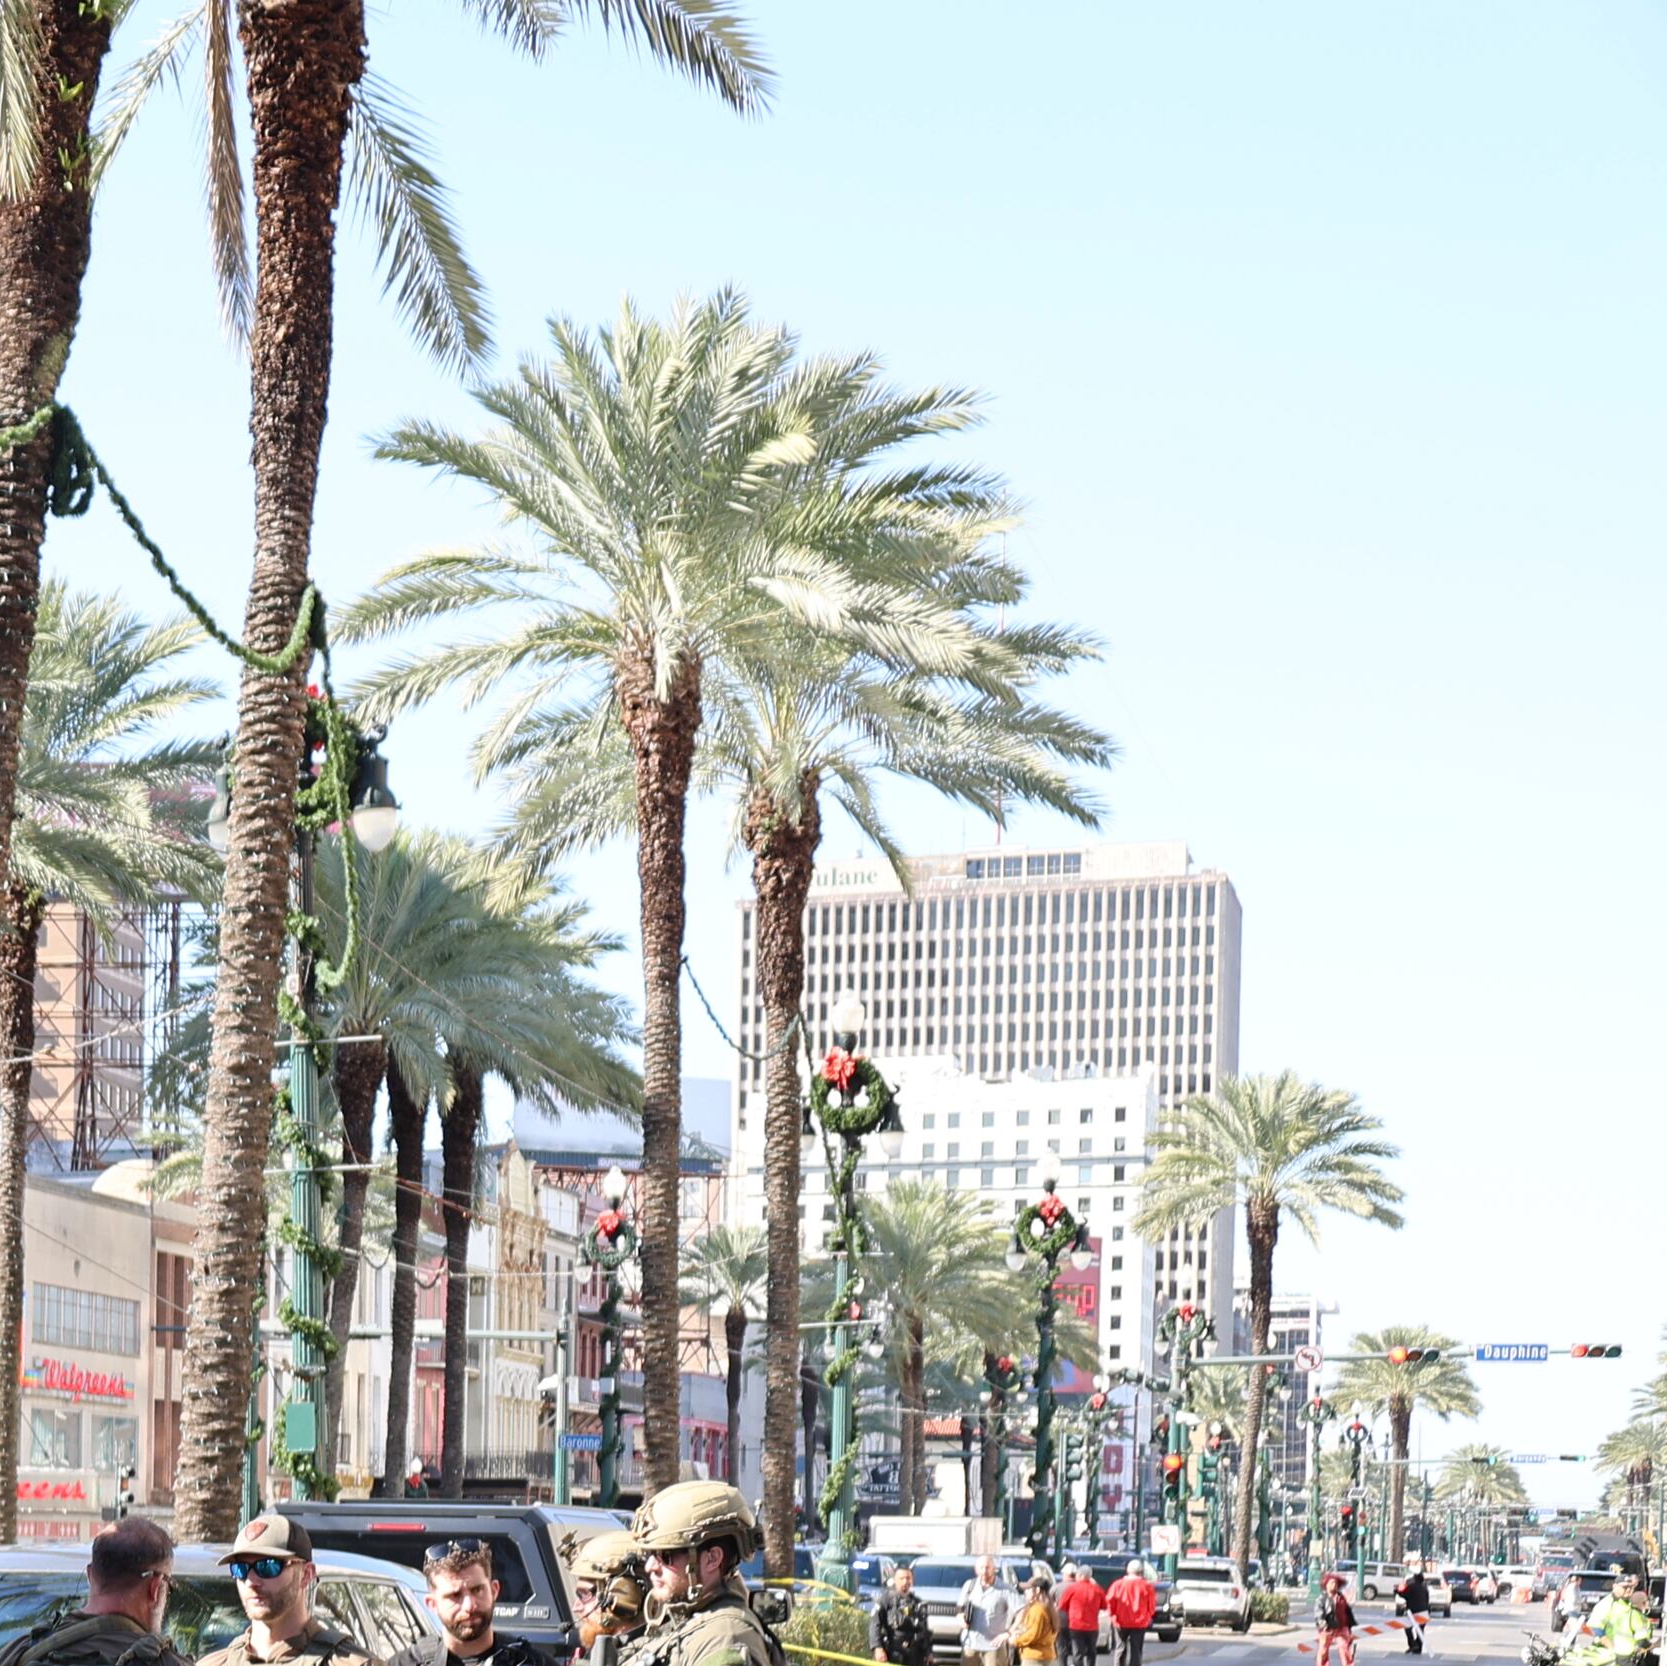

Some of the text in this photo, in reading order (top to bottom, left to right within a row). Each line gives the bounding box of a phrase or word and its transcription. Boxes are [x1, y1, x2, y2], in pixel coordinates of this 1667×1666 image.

[816, 867, 878, 886] ulane
[1484, 1344, 1547, 1361] Dauphine
[41, 1357, 127, 1401] Walgreens
[560, 1435, 601, 1449] Baronne
